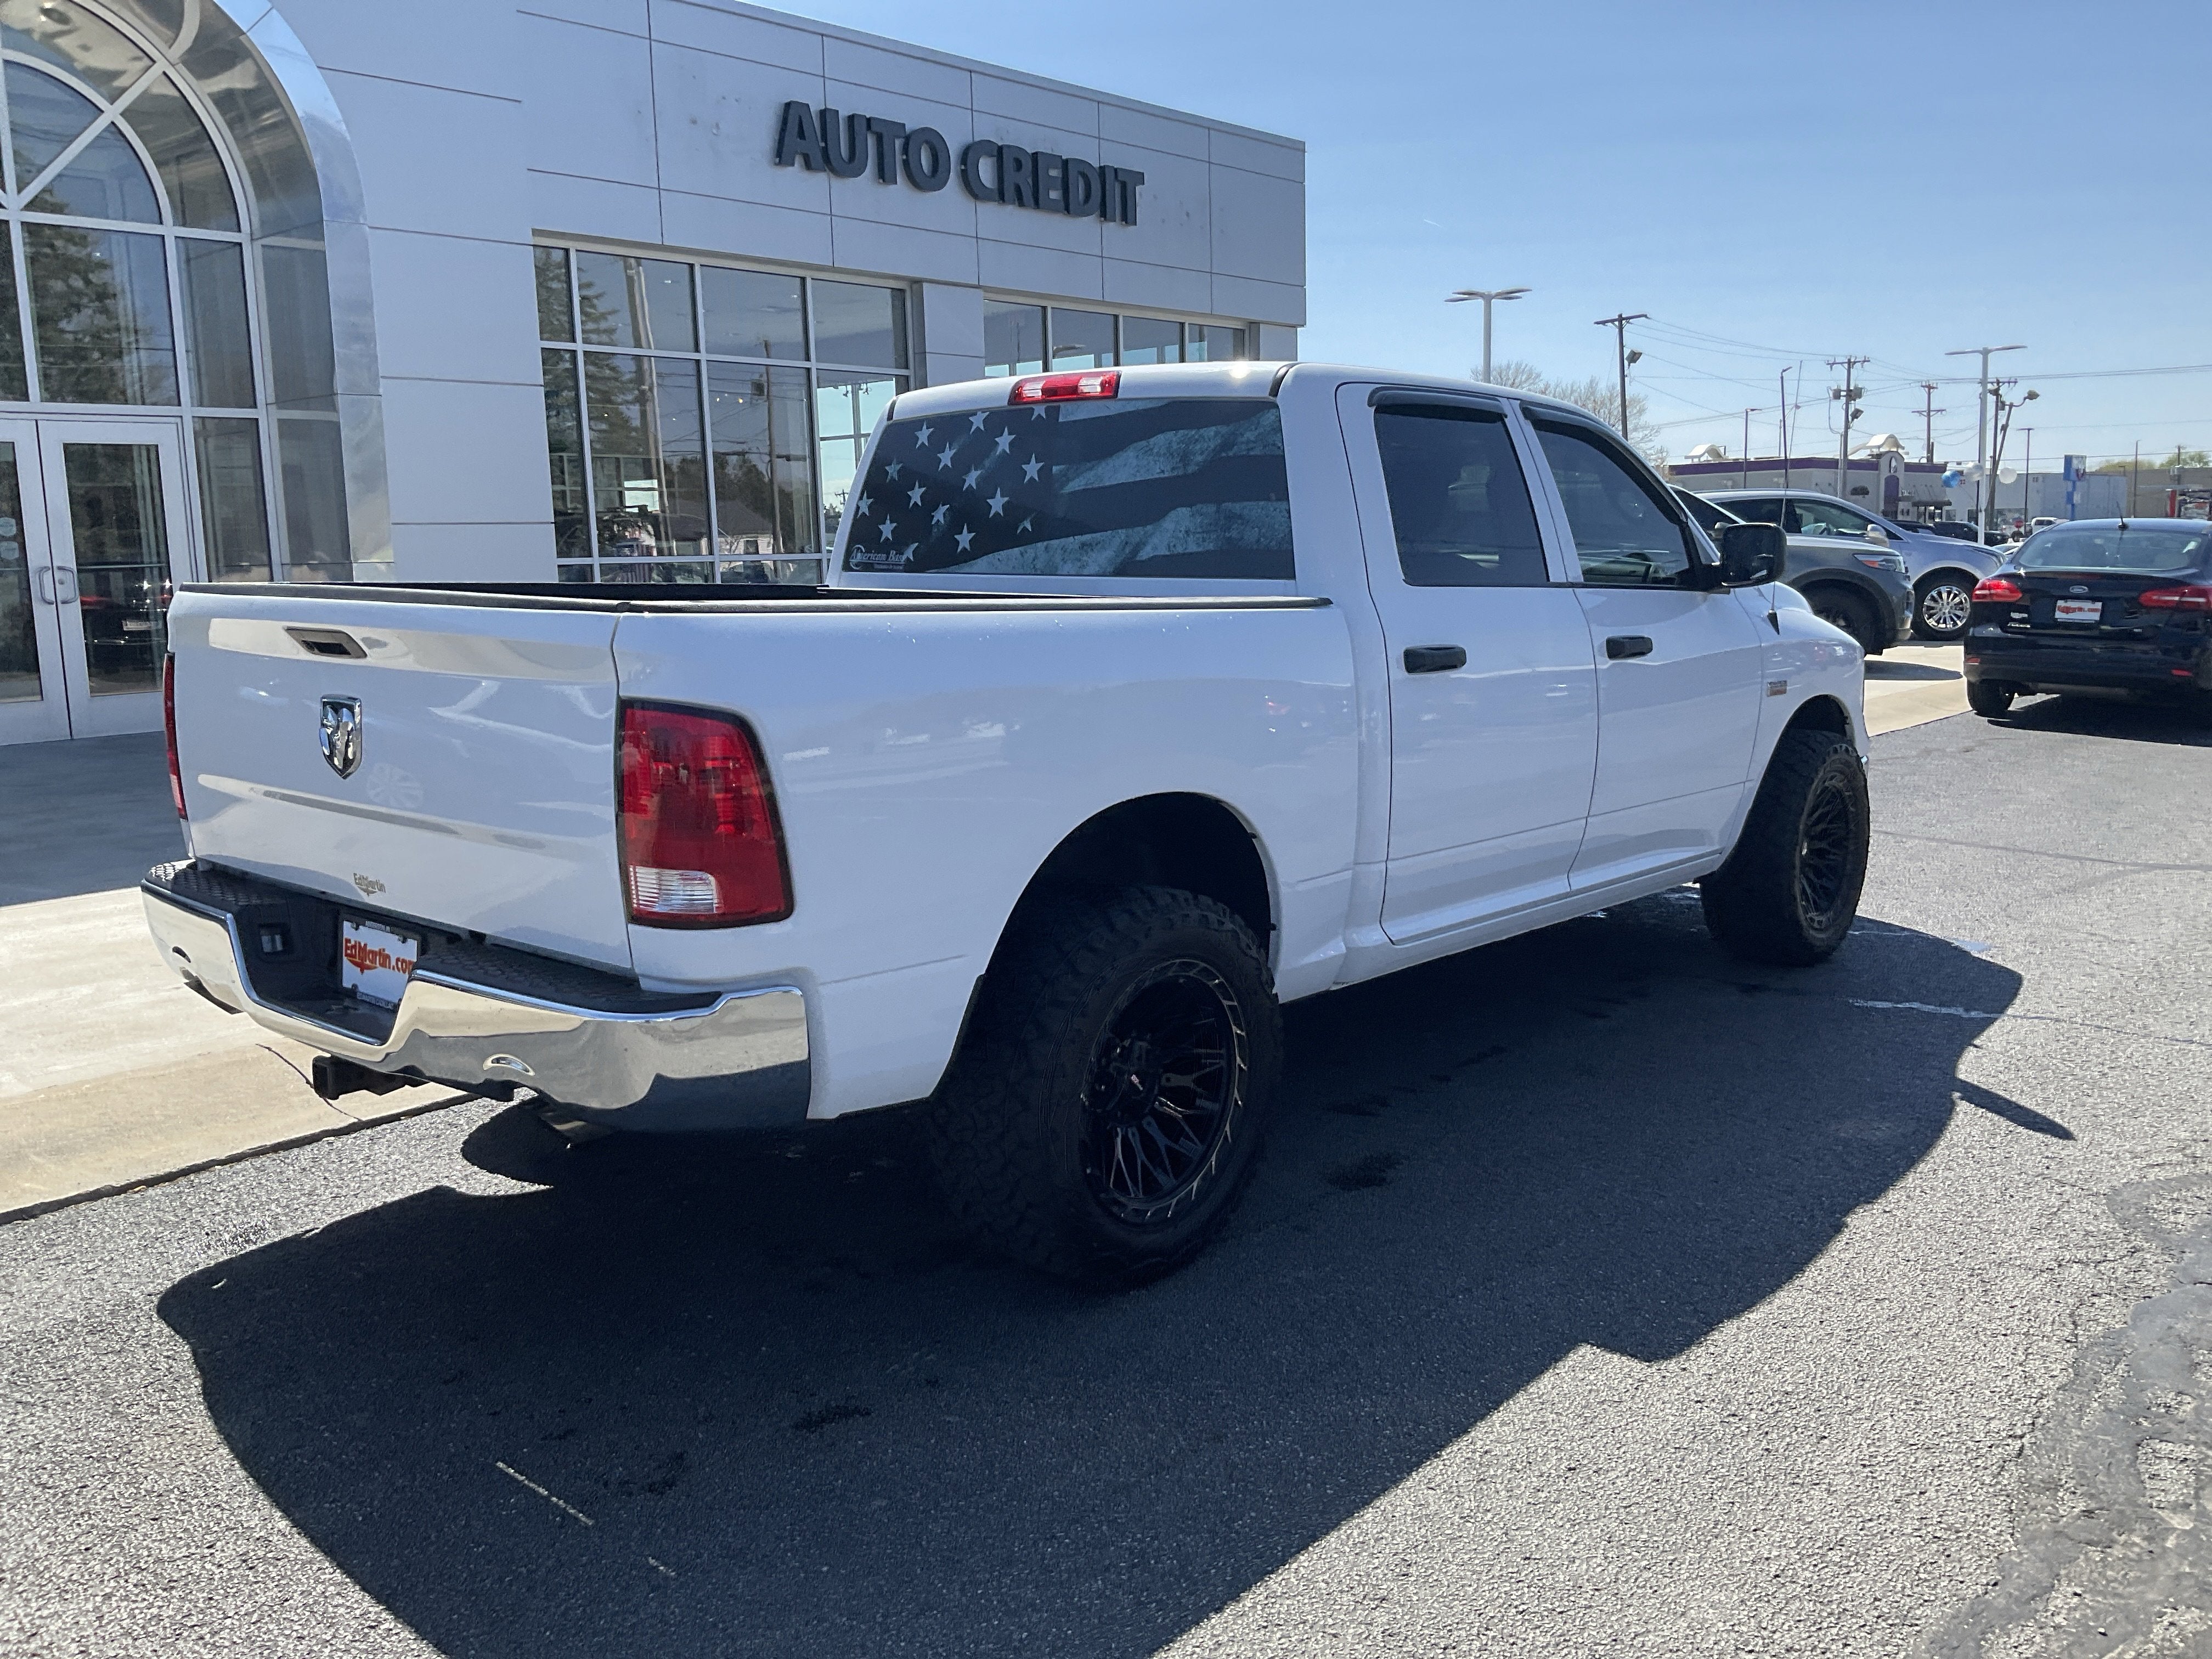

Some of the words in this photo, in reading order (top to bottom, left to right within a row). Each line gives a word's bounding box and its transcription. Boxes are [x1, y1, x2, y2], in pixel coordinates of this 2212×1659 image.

[775, 100, 951, 193] AUTO
[961, 139, 1144, 226] CREDIT
[353, 872, 386, 893] EdMartin
